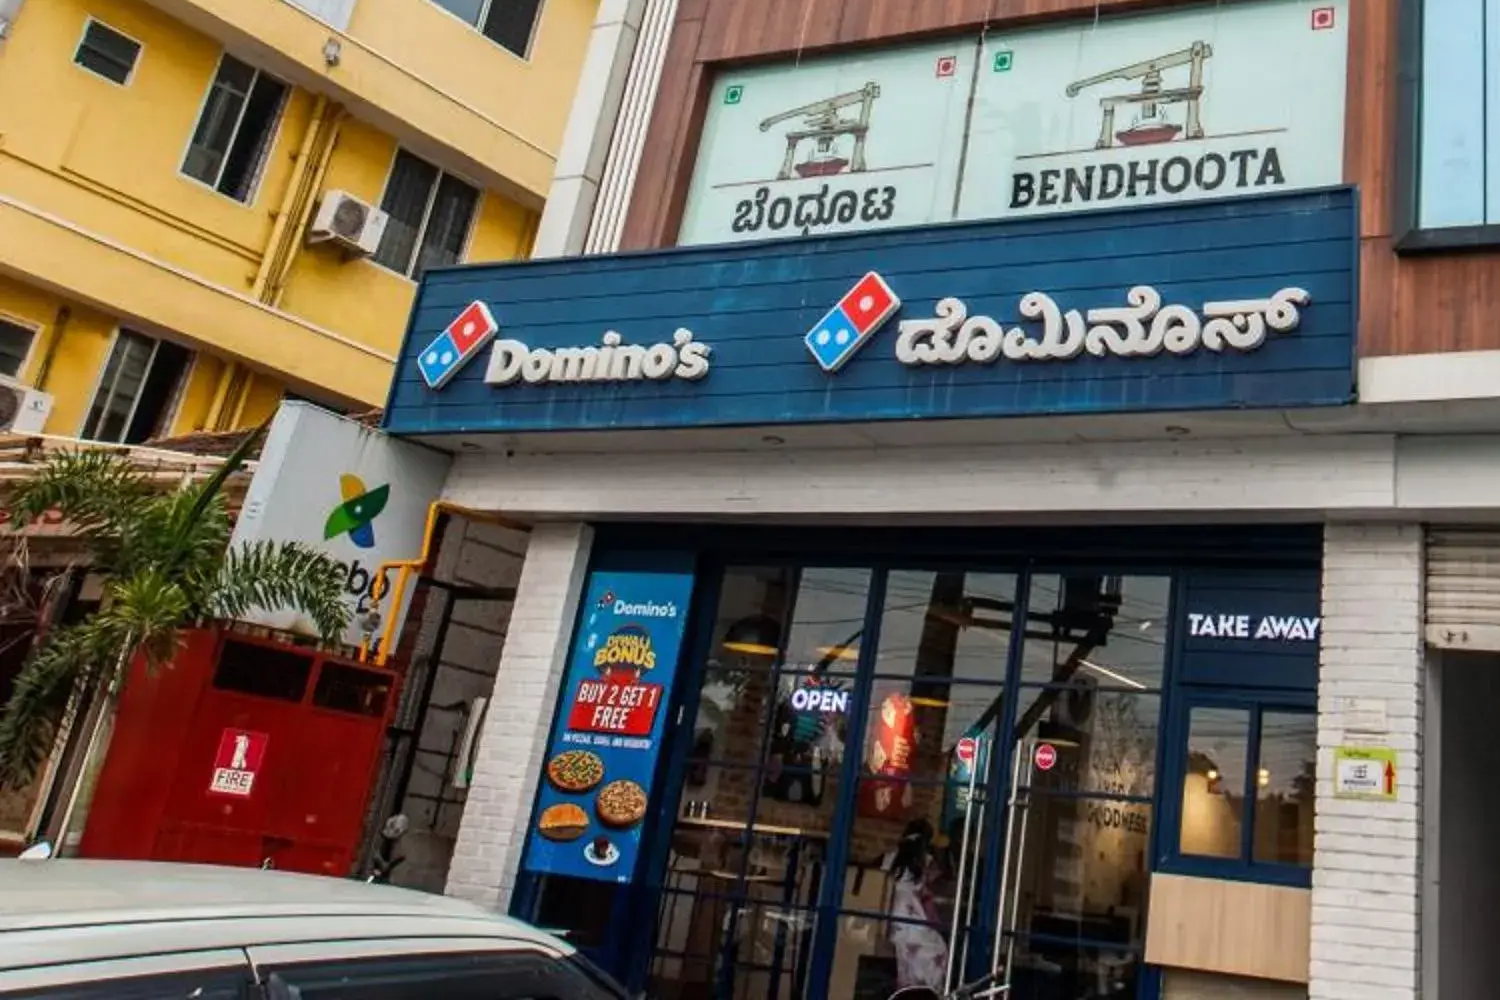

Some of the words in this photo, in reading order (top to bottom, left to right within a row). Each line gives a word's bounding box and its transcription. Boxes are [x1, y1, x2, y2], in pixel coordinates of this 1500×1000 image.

[1008, 147, 1286, 209] BENDHOOTA
[483, 327, 712, 386] Domino's
[613, 599, 677, 617] Domino's
[1188, 613, 1250, 637] TAKE
[1254, 615, 1320, 640] AWAY
[593, 646, 657, 669] BONUS
[578, 682, 608, 705] BUY
[607, 685, 619, 705] 2
[620, 685, 647, 707] GET
[648, 688, 657, 707] 1
[792, 689, 848, 712] OPEN
[591, 705, 630, 729] FREE
[217, 770, 250, 787] FIRE
